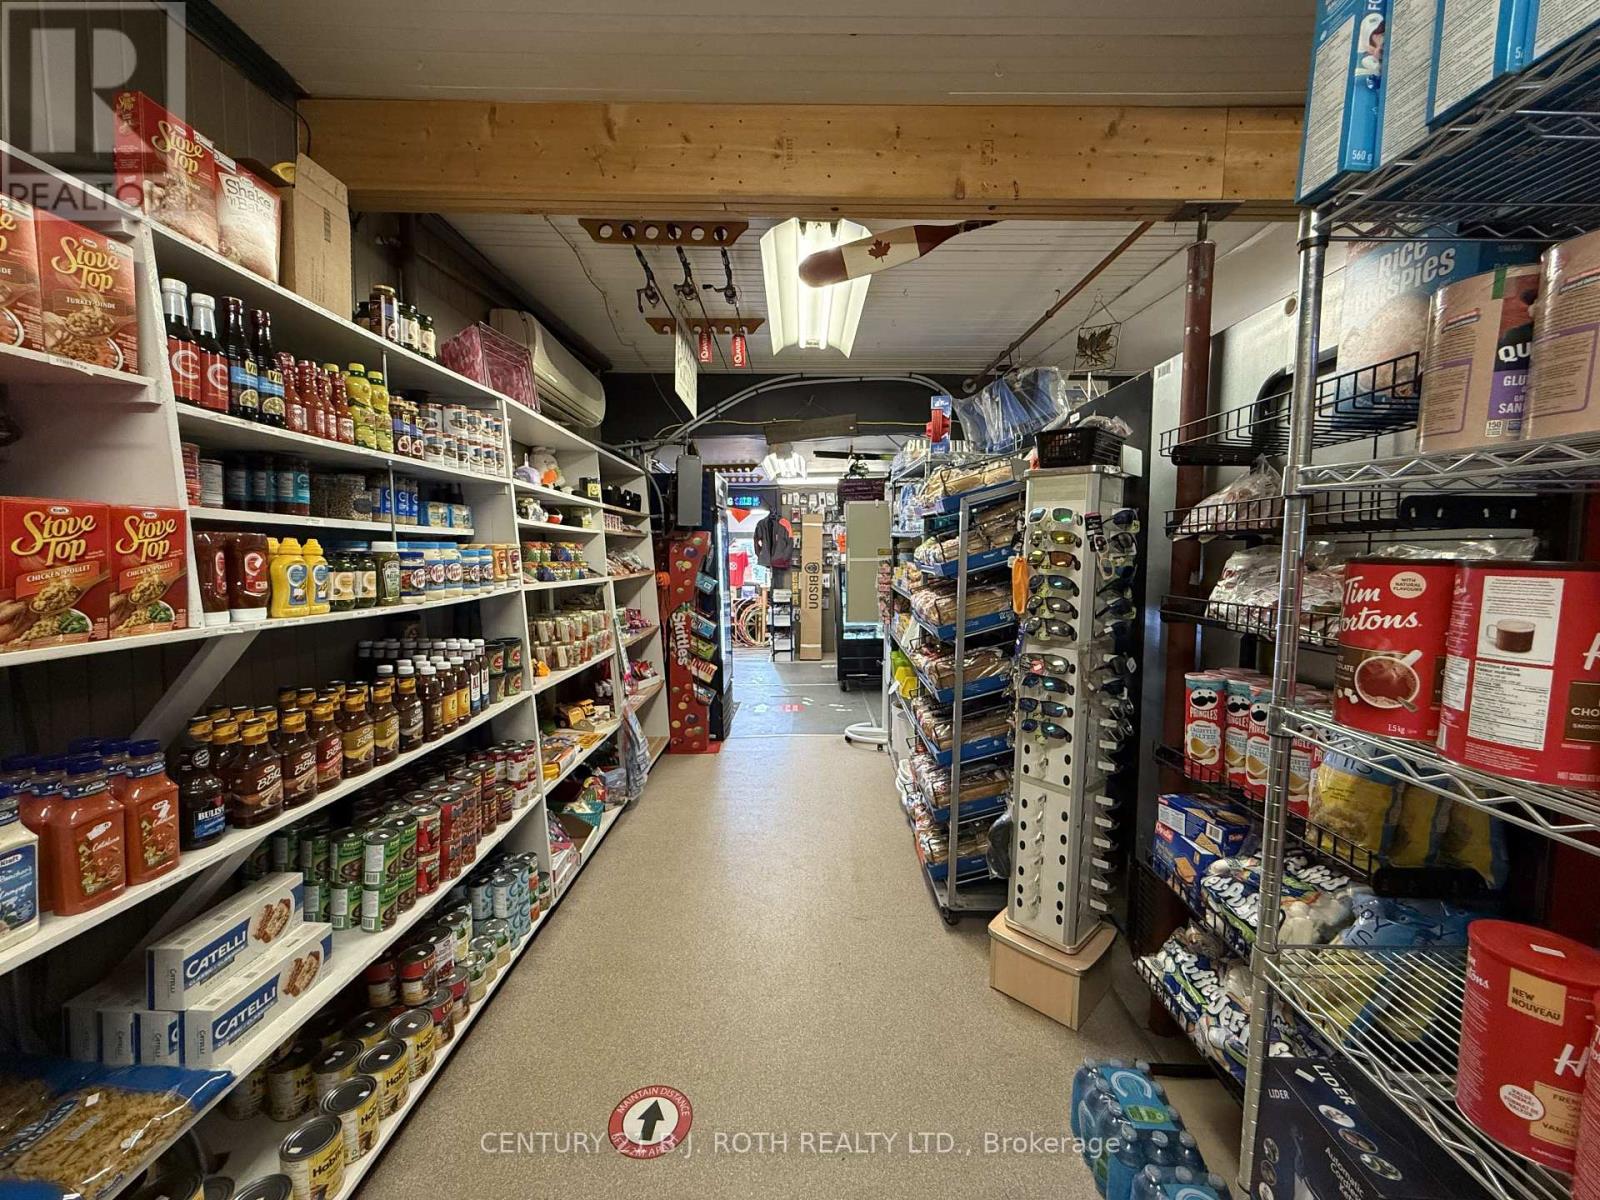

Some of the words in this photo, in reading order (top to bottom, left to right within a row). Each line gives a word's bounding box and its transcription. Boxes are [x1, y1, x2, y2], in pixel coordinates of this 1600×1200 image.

[152, 121, 204, 158] Stove
[172, 148, 199, 174] Top
[1352, 150, 1366, 160] 560
[51, 236, 121, 274] Stove
[78, 266, 113, 293] Top
[11, 511, 97, 556] Stove
[115, 515, 178, 554] Stove
[44, 538, 87, 567] Top
[139, 538, 170, 563] Top
[27, 570, 61, 583] CHICKEN
[1344, 576, 1381, 606] Tim
[808, 576, 819, 609] BISON
[671, 612, 690, 666] Skittles
[1190, 707, 1218, 720] PRINGLES
[257, 768, 282, 790] BBQ
[295, 755, 317, 776] BBQ
[186, 931, 246, 978] CATELLI
[1511, 996, 1561, 1021] NOUVEAU
[1512, 987, 1535, 1001] NEW
[215, 987, 276, 1039] CATELLI
[1268, 1089, 1290, 1099] LIDER
[1312, 1064, 1356, 1105] LIDER
[616, 1087, 659, 1114] MAINTAIN
[659, 1087, 690, 1117] DISTANCE
